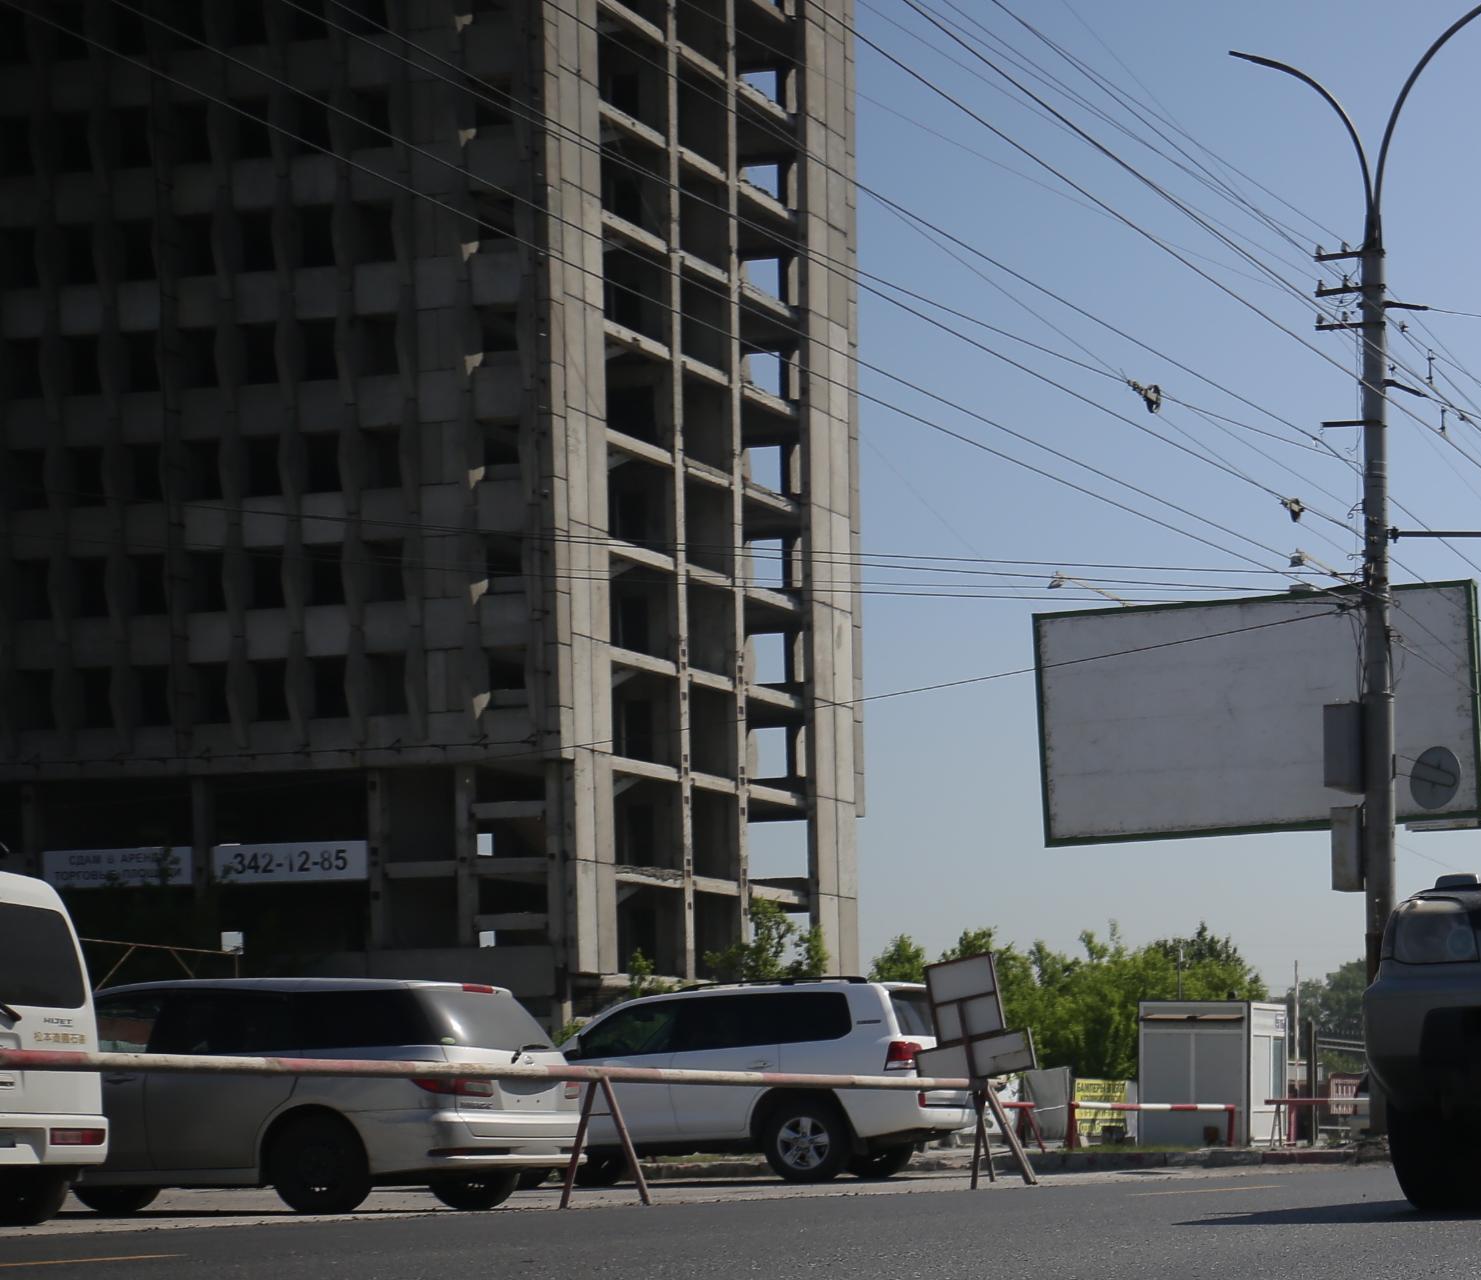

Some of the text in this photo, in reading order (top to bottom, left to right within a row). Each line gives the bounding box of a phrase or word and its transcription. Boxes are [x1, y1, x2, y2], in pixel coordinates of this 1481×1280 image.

[68, 855, 102, 866] СДАМ
[232, 849, 348, 875] 342-12-85
[54, 867, 182, 881] ТОРГОВЫ ПЛОЩИ
